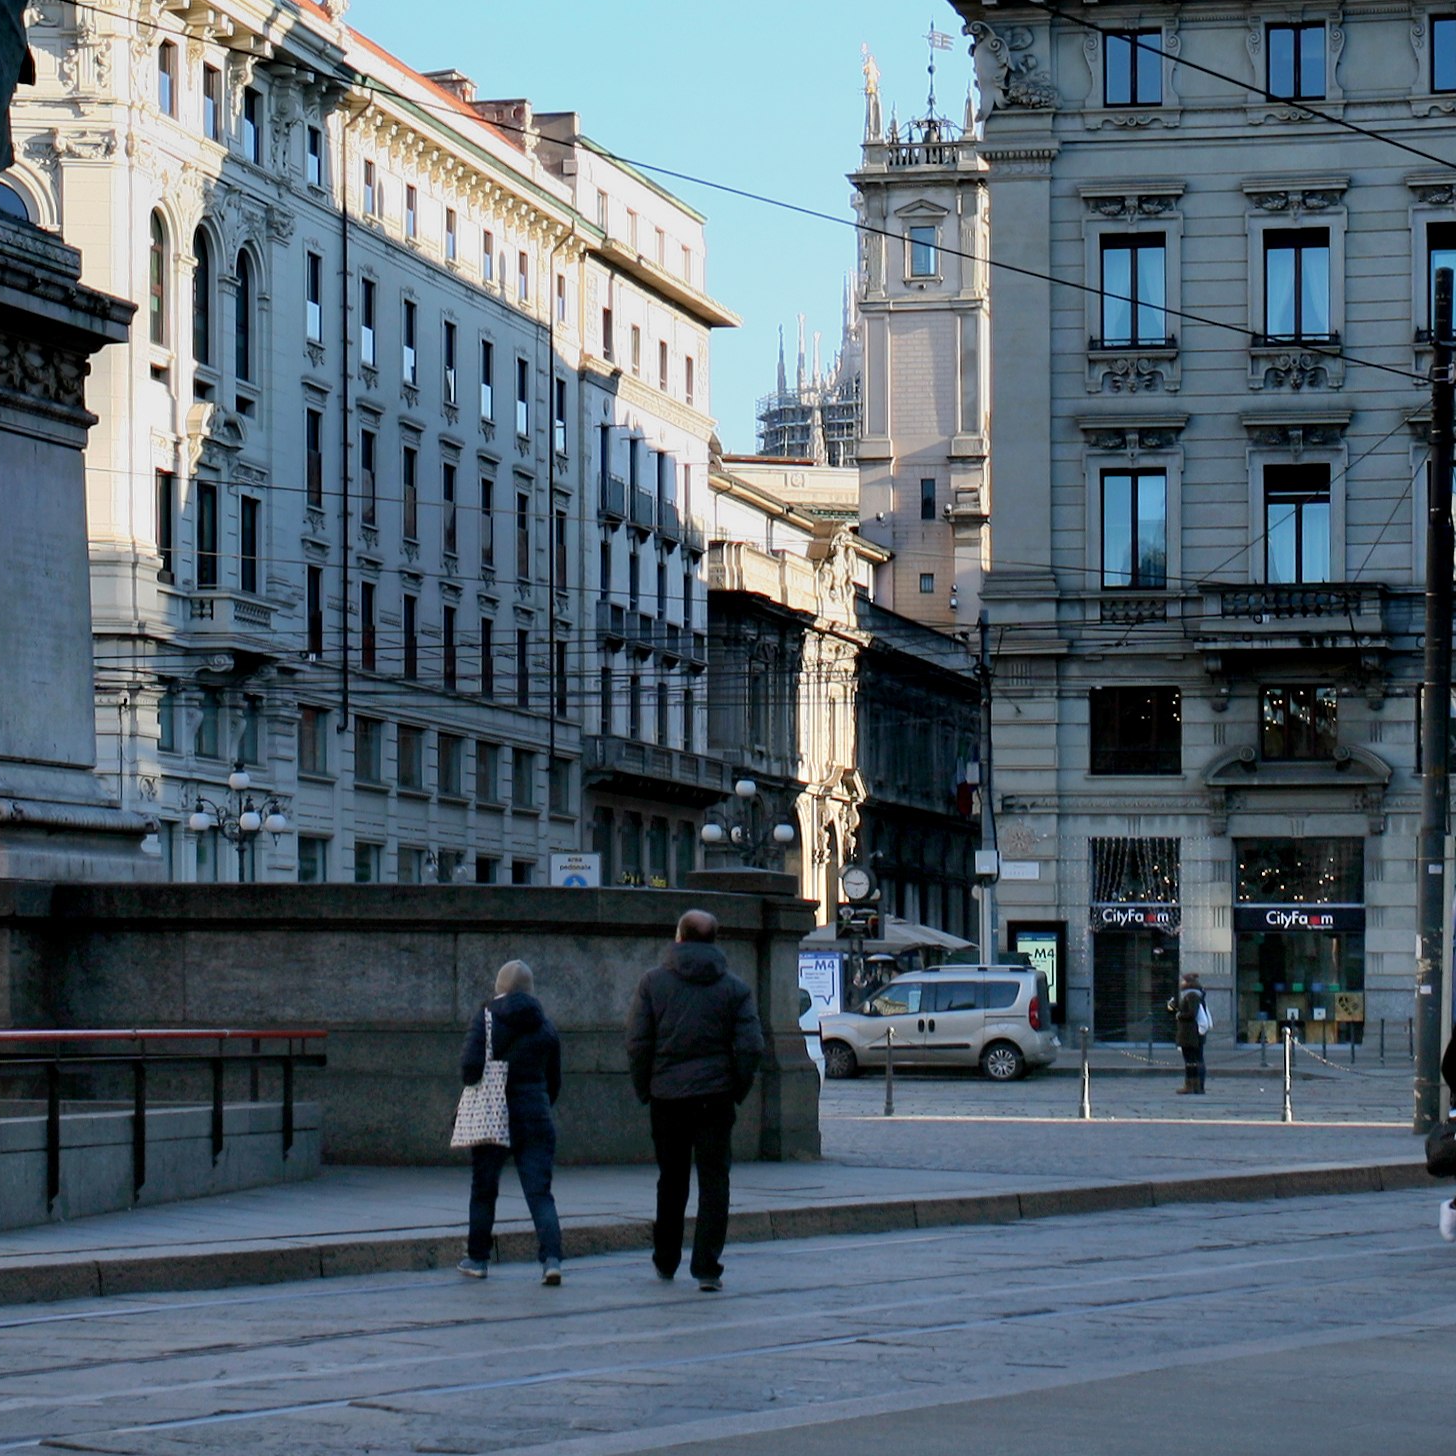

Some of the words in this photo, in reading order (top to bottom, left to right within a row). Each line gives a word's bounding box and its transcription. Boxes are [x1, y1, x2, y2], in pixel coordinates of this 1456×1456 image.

[1102, 908, 1169, 927] CityFam
[1265, 910, 1334, 929] CityFam
[1034, 948, 1055, 959] M4
[814, 959, 835, 971] M4
